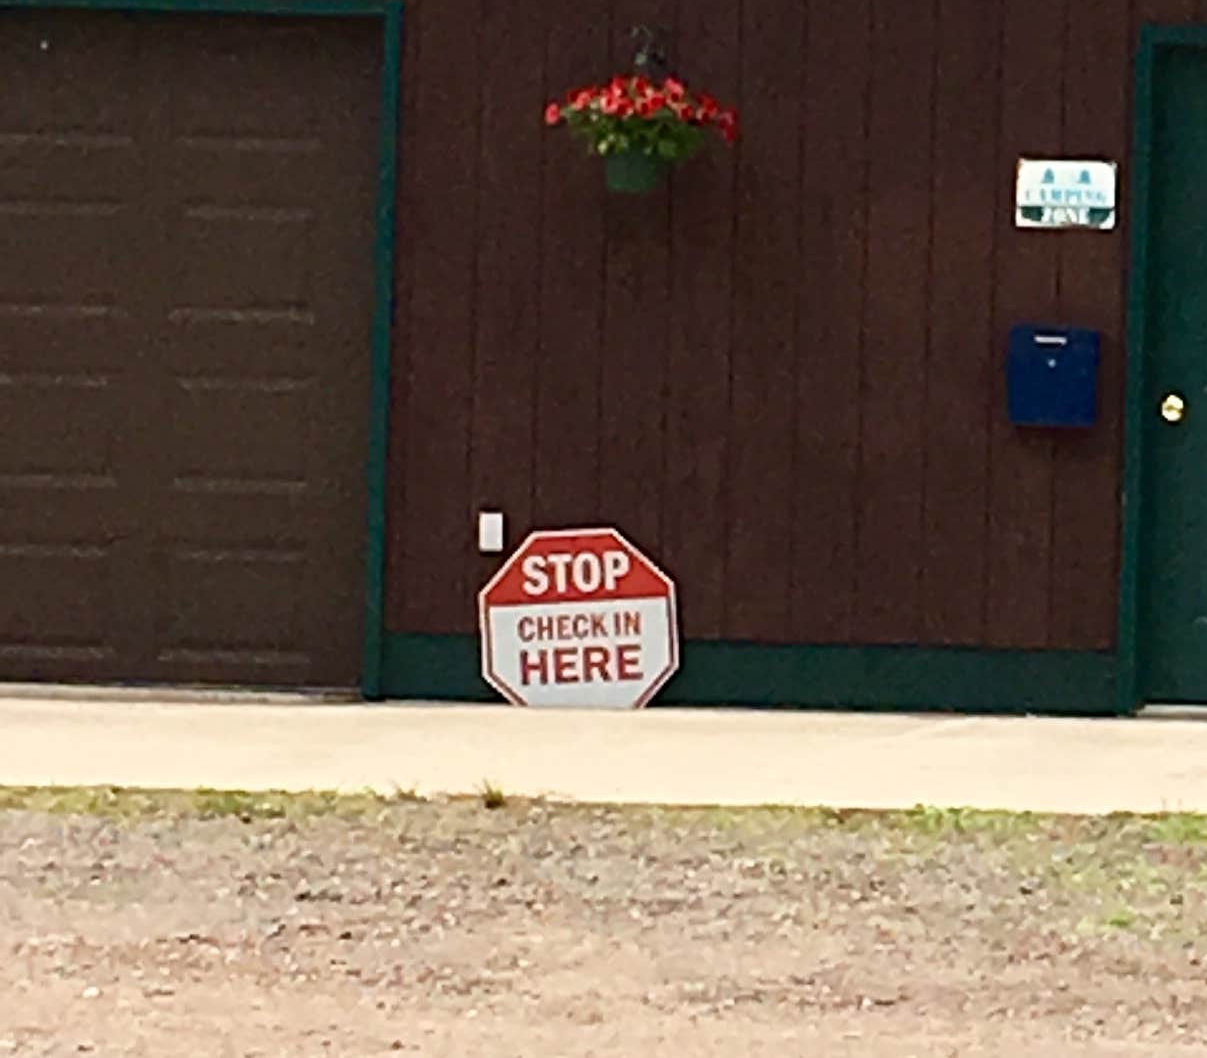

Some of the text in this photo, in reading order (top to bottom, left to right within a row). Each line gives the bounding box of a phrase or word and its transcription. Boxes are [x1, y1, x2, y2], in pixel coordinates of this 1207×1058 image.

[521, 550, 630, 595] STOP
[518, 610, 641, 641] CHECK IN
[519, 644, 644, 686] HERE
